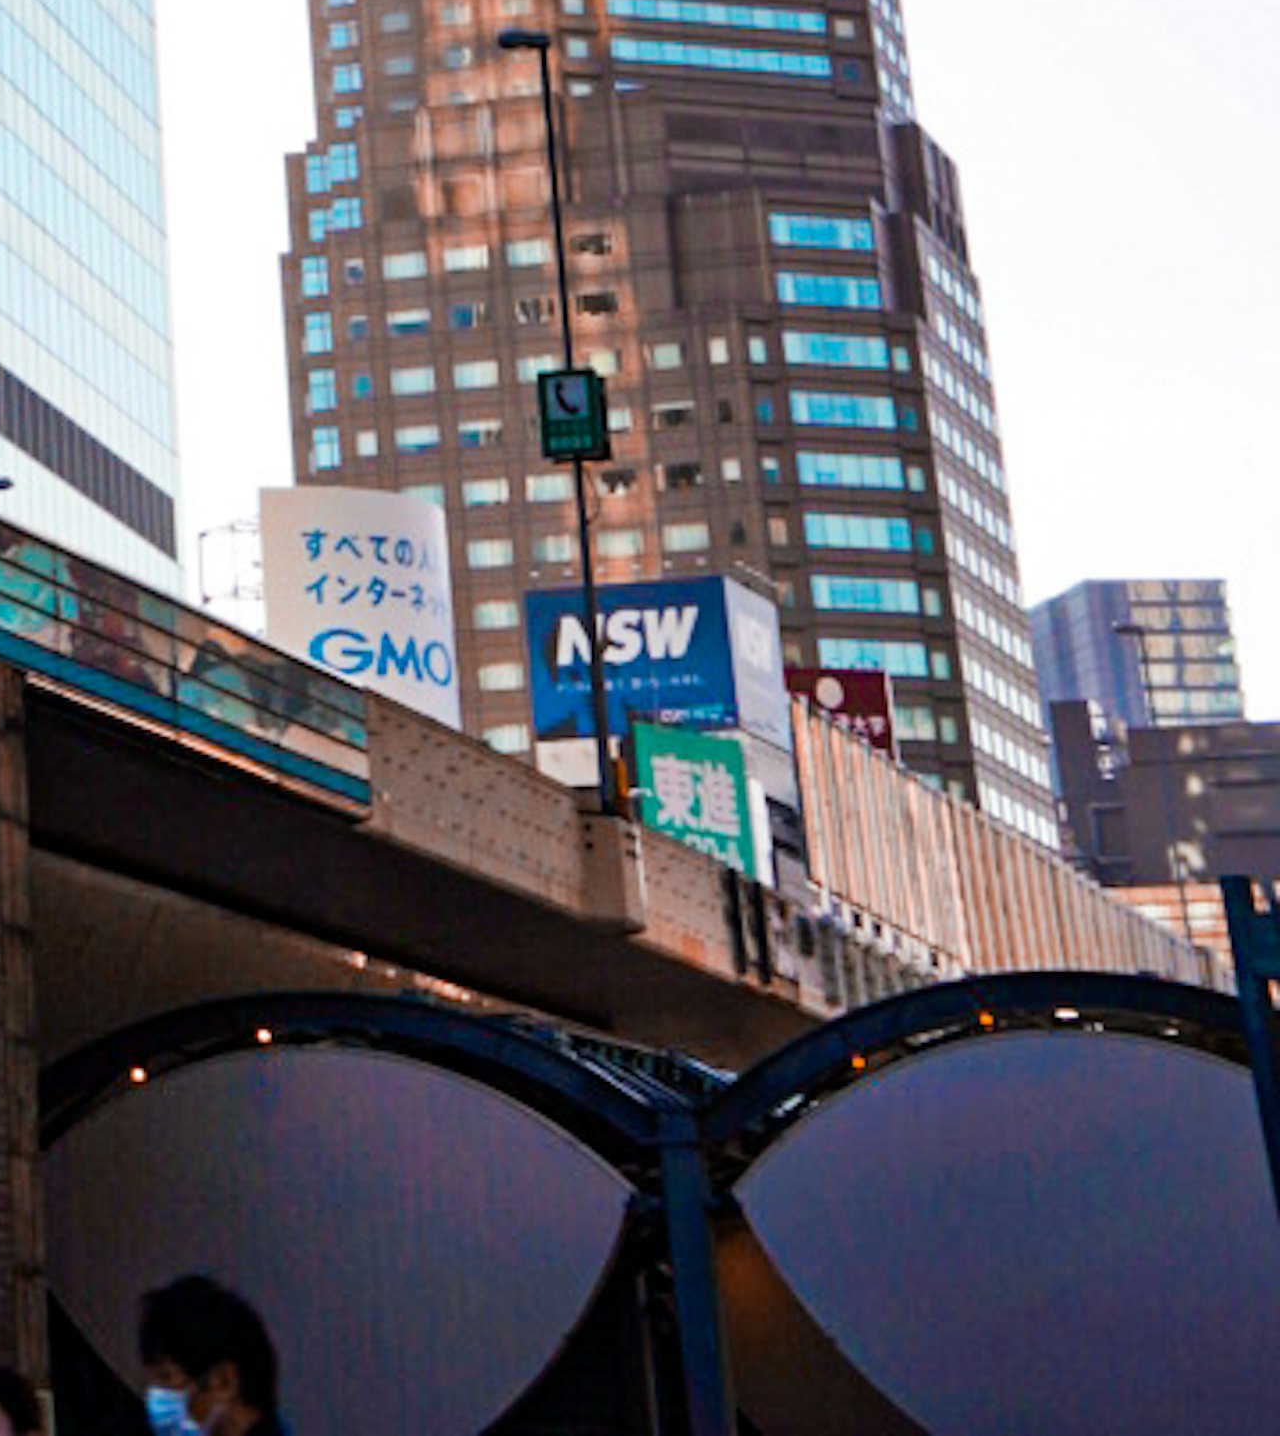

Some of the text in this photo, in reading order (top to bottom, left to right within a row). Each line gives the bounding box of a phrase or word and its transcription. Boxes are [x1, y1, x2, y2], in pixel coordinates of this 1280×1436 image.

[309, 627, 452, 687] GMO
[556, 605, 699, 667] NSW
[650, 752, 741, 836] 東進
